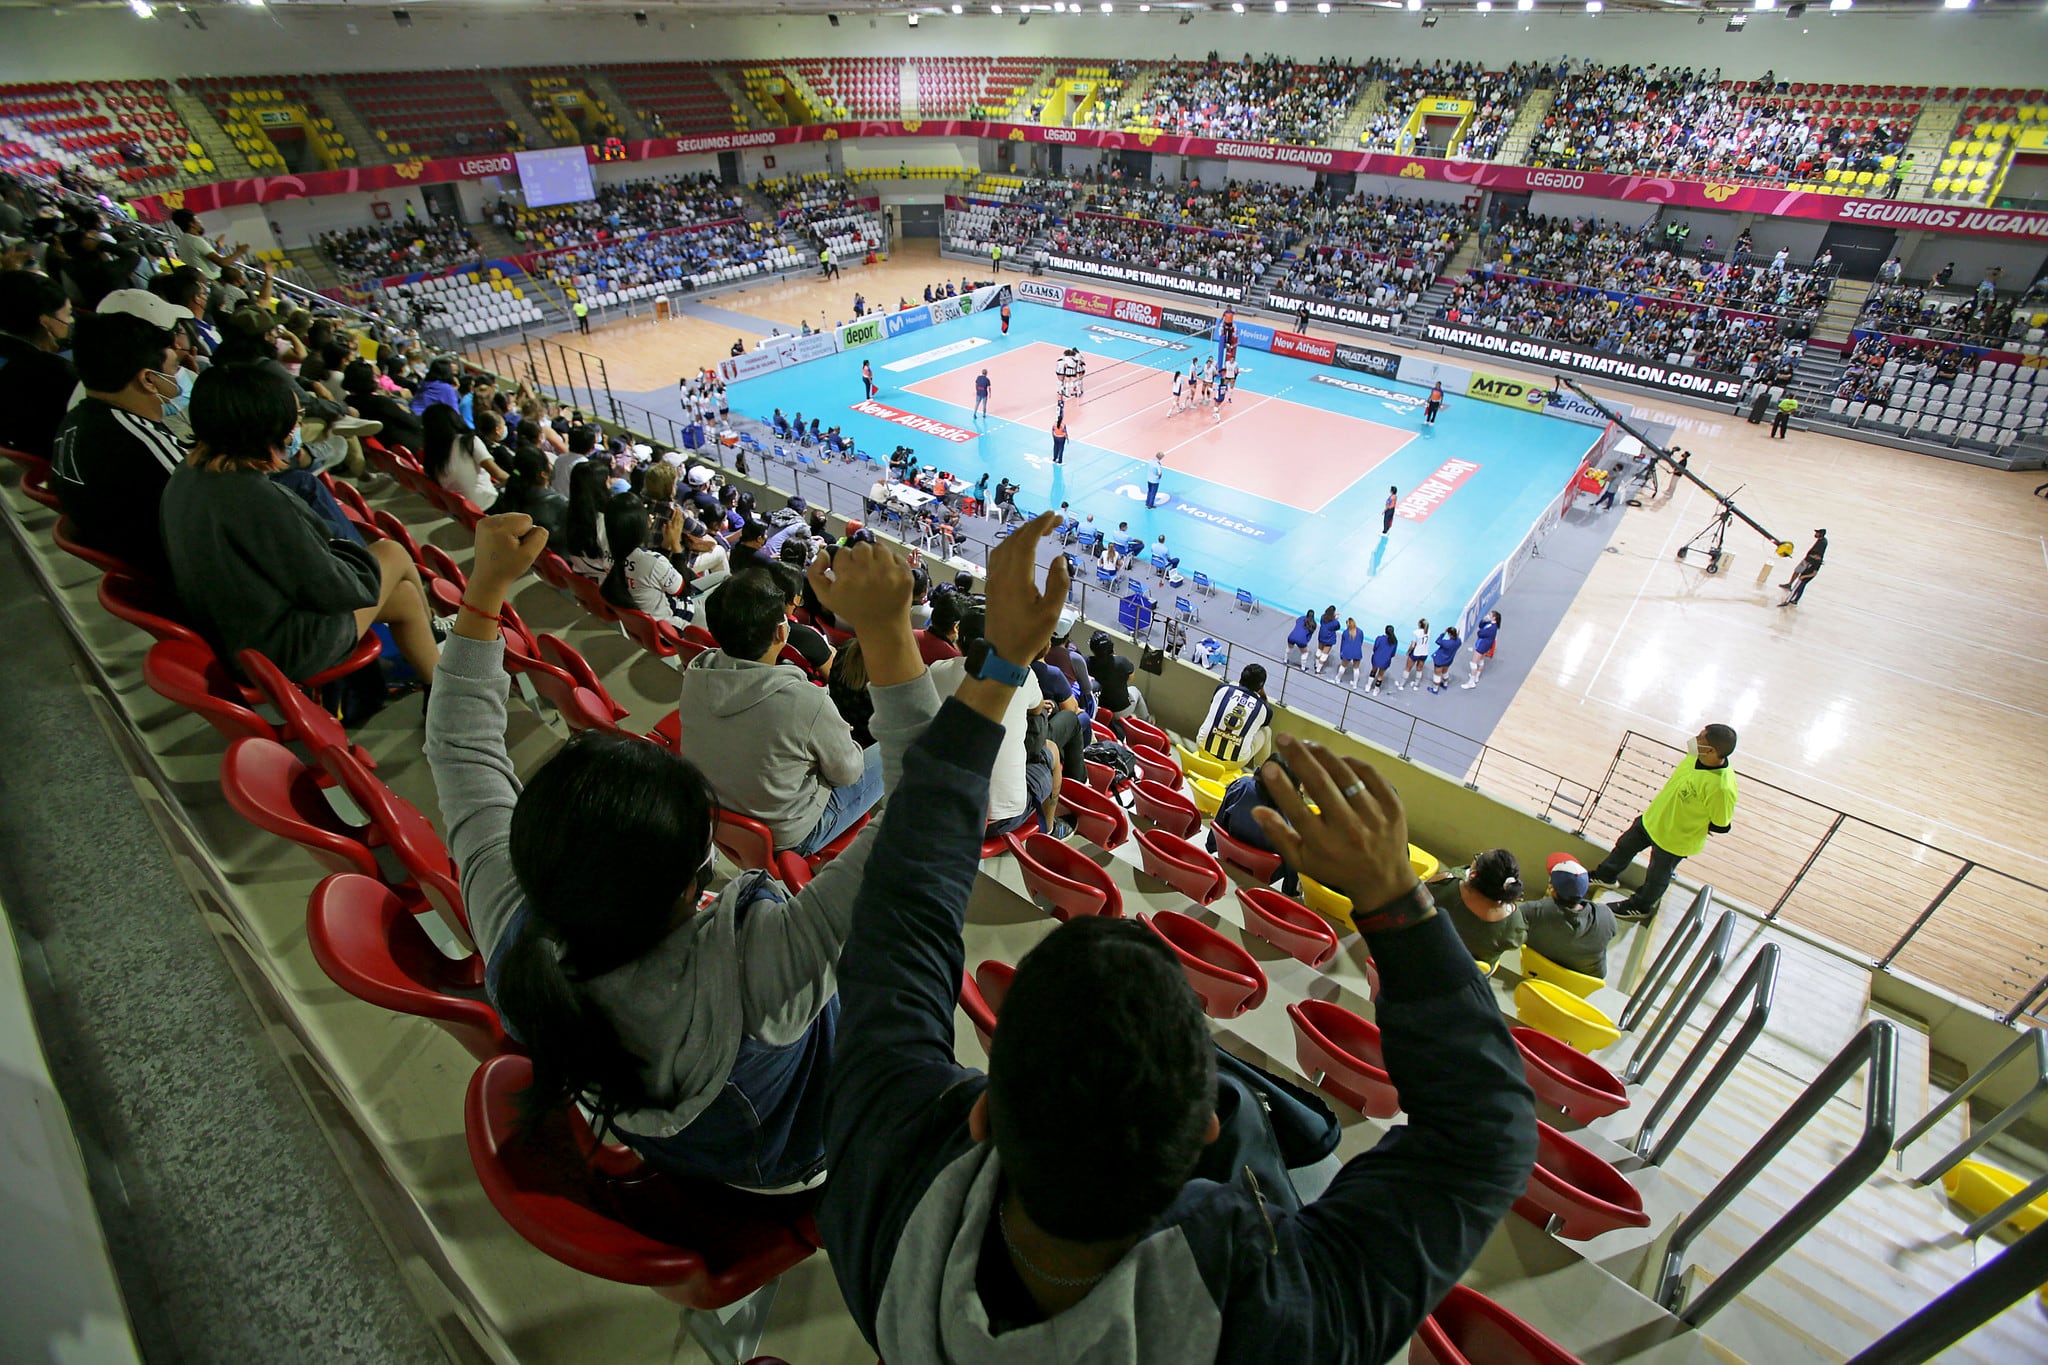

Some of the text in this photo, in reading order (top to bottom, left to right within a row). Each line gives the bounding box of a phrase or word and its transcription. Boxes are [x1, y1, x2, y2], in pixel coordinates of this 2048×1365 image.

[677, 132, 776, 152] SEGUIMOS JUGANDO
[1215, 142, 1333, 165] SEGUIMOS JUGANDO
[1839, 201, 1960, 228] SEGUIMOS
[1049, 256, 1241, 300] TRIATHLON.COM.PE TRIATHLON.COM.PE
[1021, 283, 1060, 300] JAAMSA
[1114, 310, 1157, 326] OLIVEROS
[1162, 312, 1206, 329] TRIATHLON
[846, 324, 874, 345] depor
[1240, 328, 1270, 342] Movistar
[1274, 337, 1331, 359] New Athletic
[1336, 349, 1389, 366] TRIATHLON
[1427, 324, 1741, 397] TRIATHLON.COM.PE TRIATHLON.COM.PE
[1472, 377, 1523, 397] MTD
[851, 401, 969, 442] New Athletic
[1395, 458, 1478, 518] New Athletic
[1176, 503, 1266, 536] Movistar
[1223, 705, 1247, 730] 8
